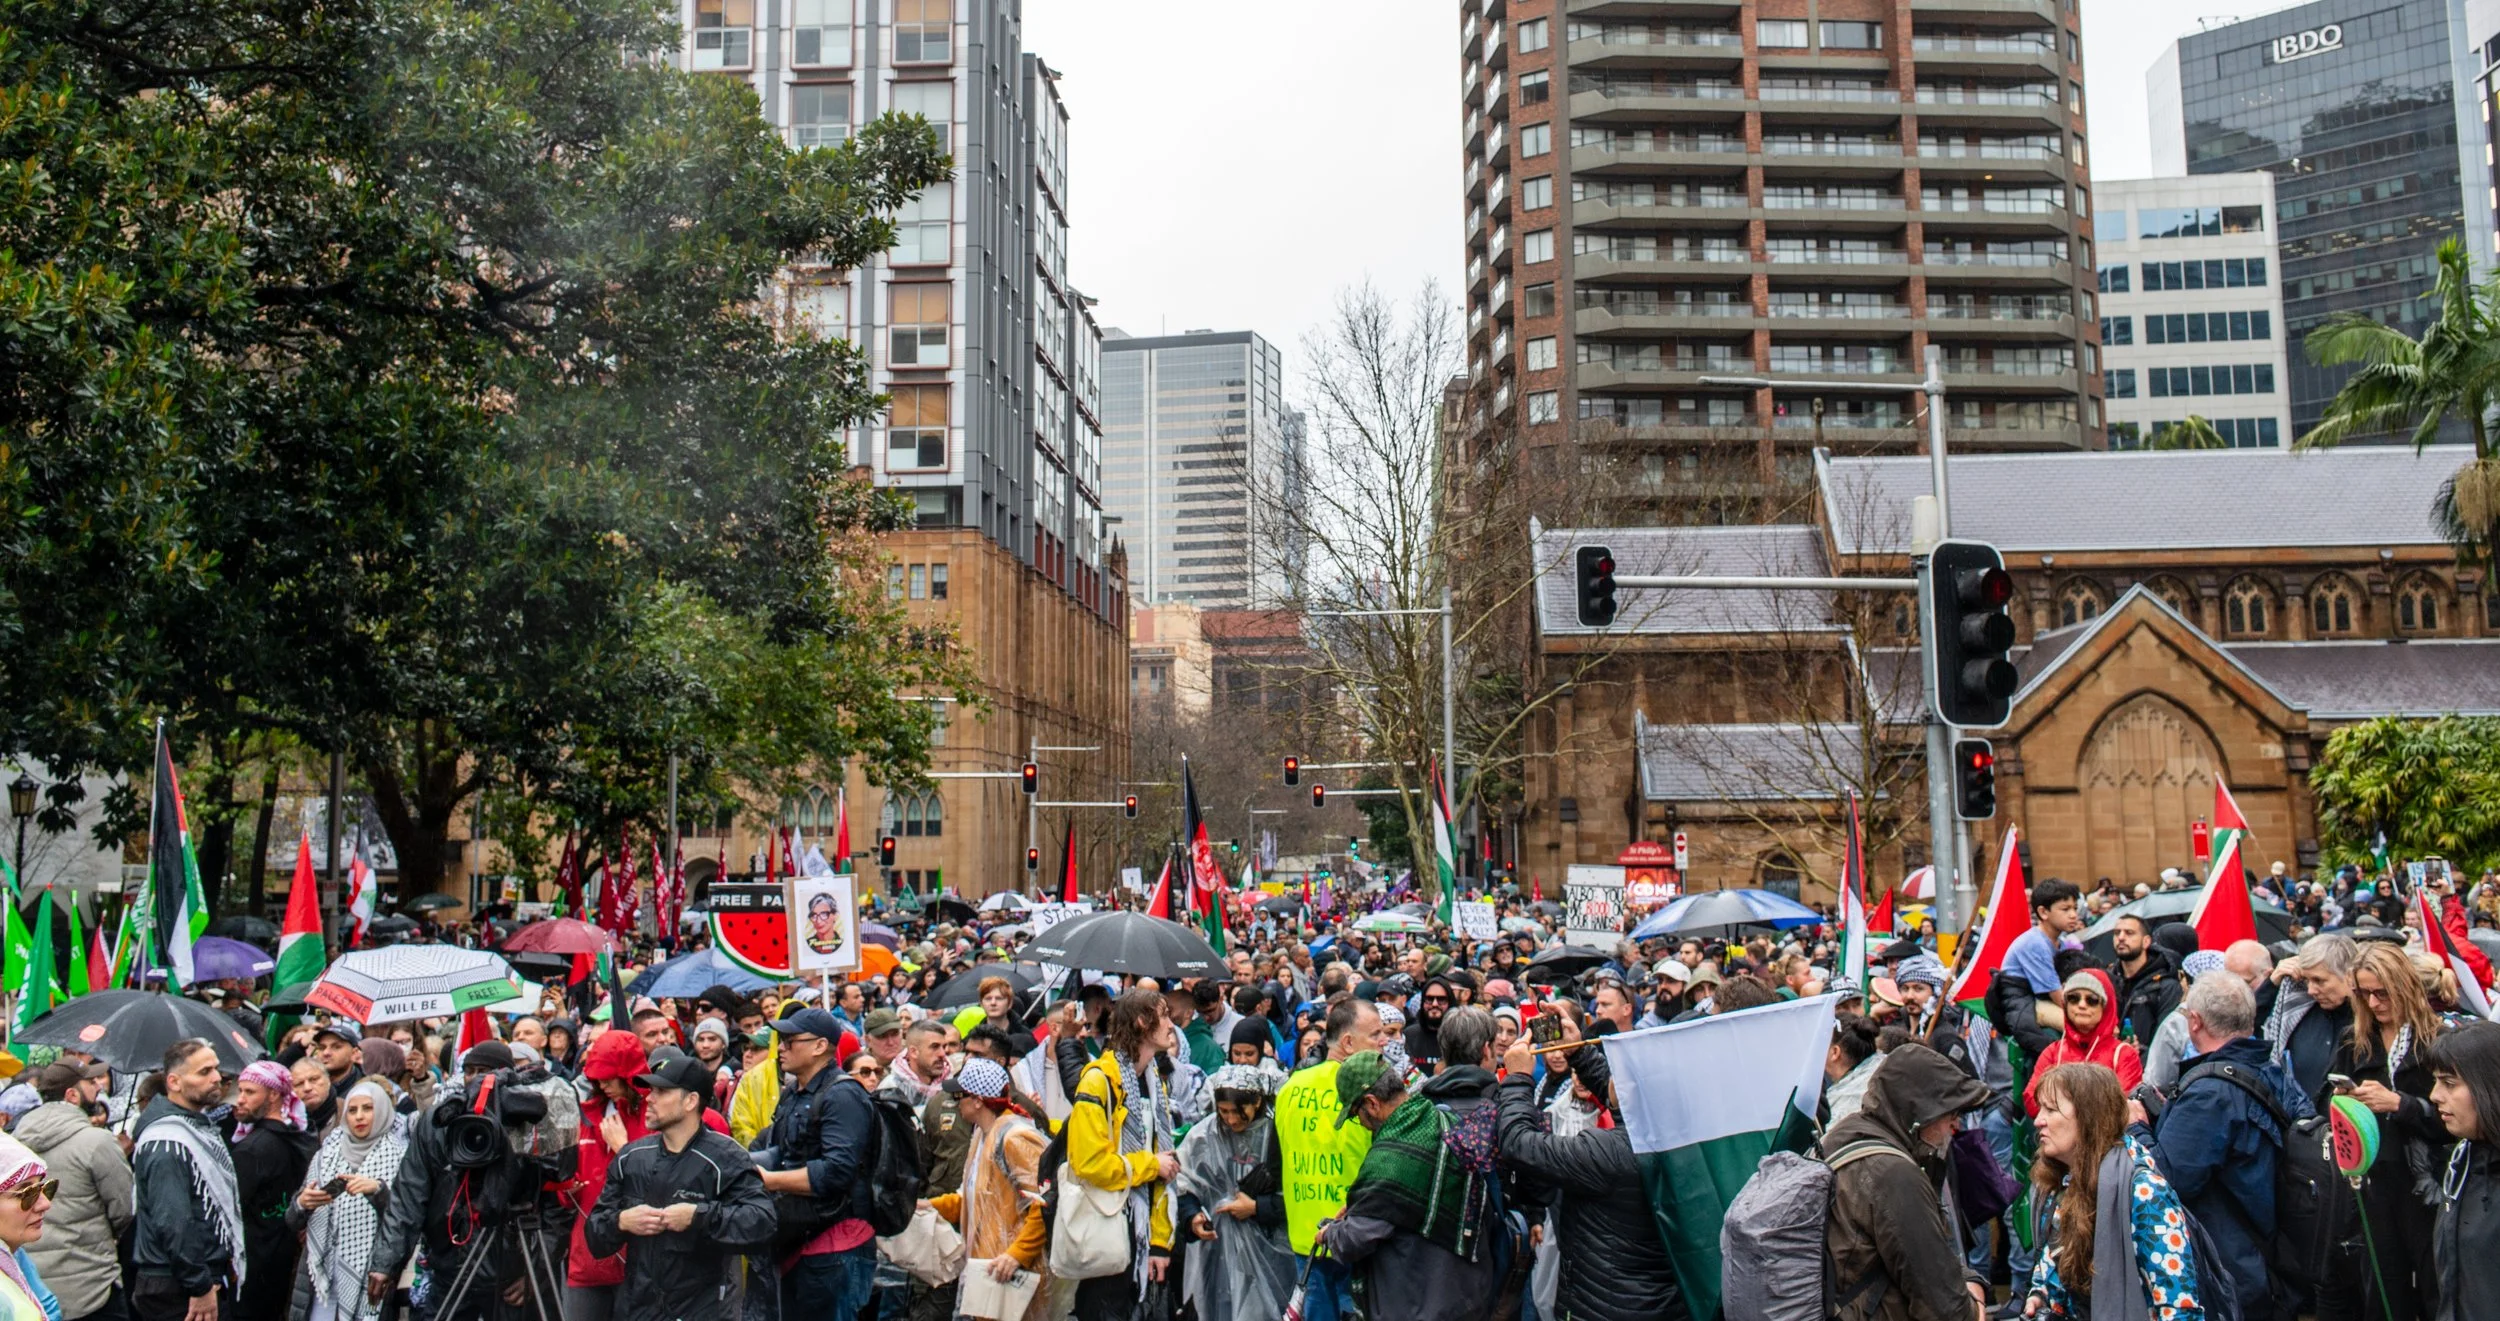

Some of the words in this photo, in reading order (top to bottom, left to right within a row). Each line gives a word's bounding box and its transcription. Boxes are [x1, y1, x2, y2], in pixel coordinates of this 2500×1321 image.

[2280, 25, 2342, 57] BDO
[711, 894, 752, 906] FREE
[1602, 886, 1624, 903] YOU
[315, 985, 369, 1015] PALESTINE
[385, 1002, 416, 1015] WILL
[421, 999, 438, 1011] BE
[467, 986, 500, 1001] FREE!
[1302, 1117, 1318, 1132] IS
[1293, 1151, 1343, 1176] UNION
